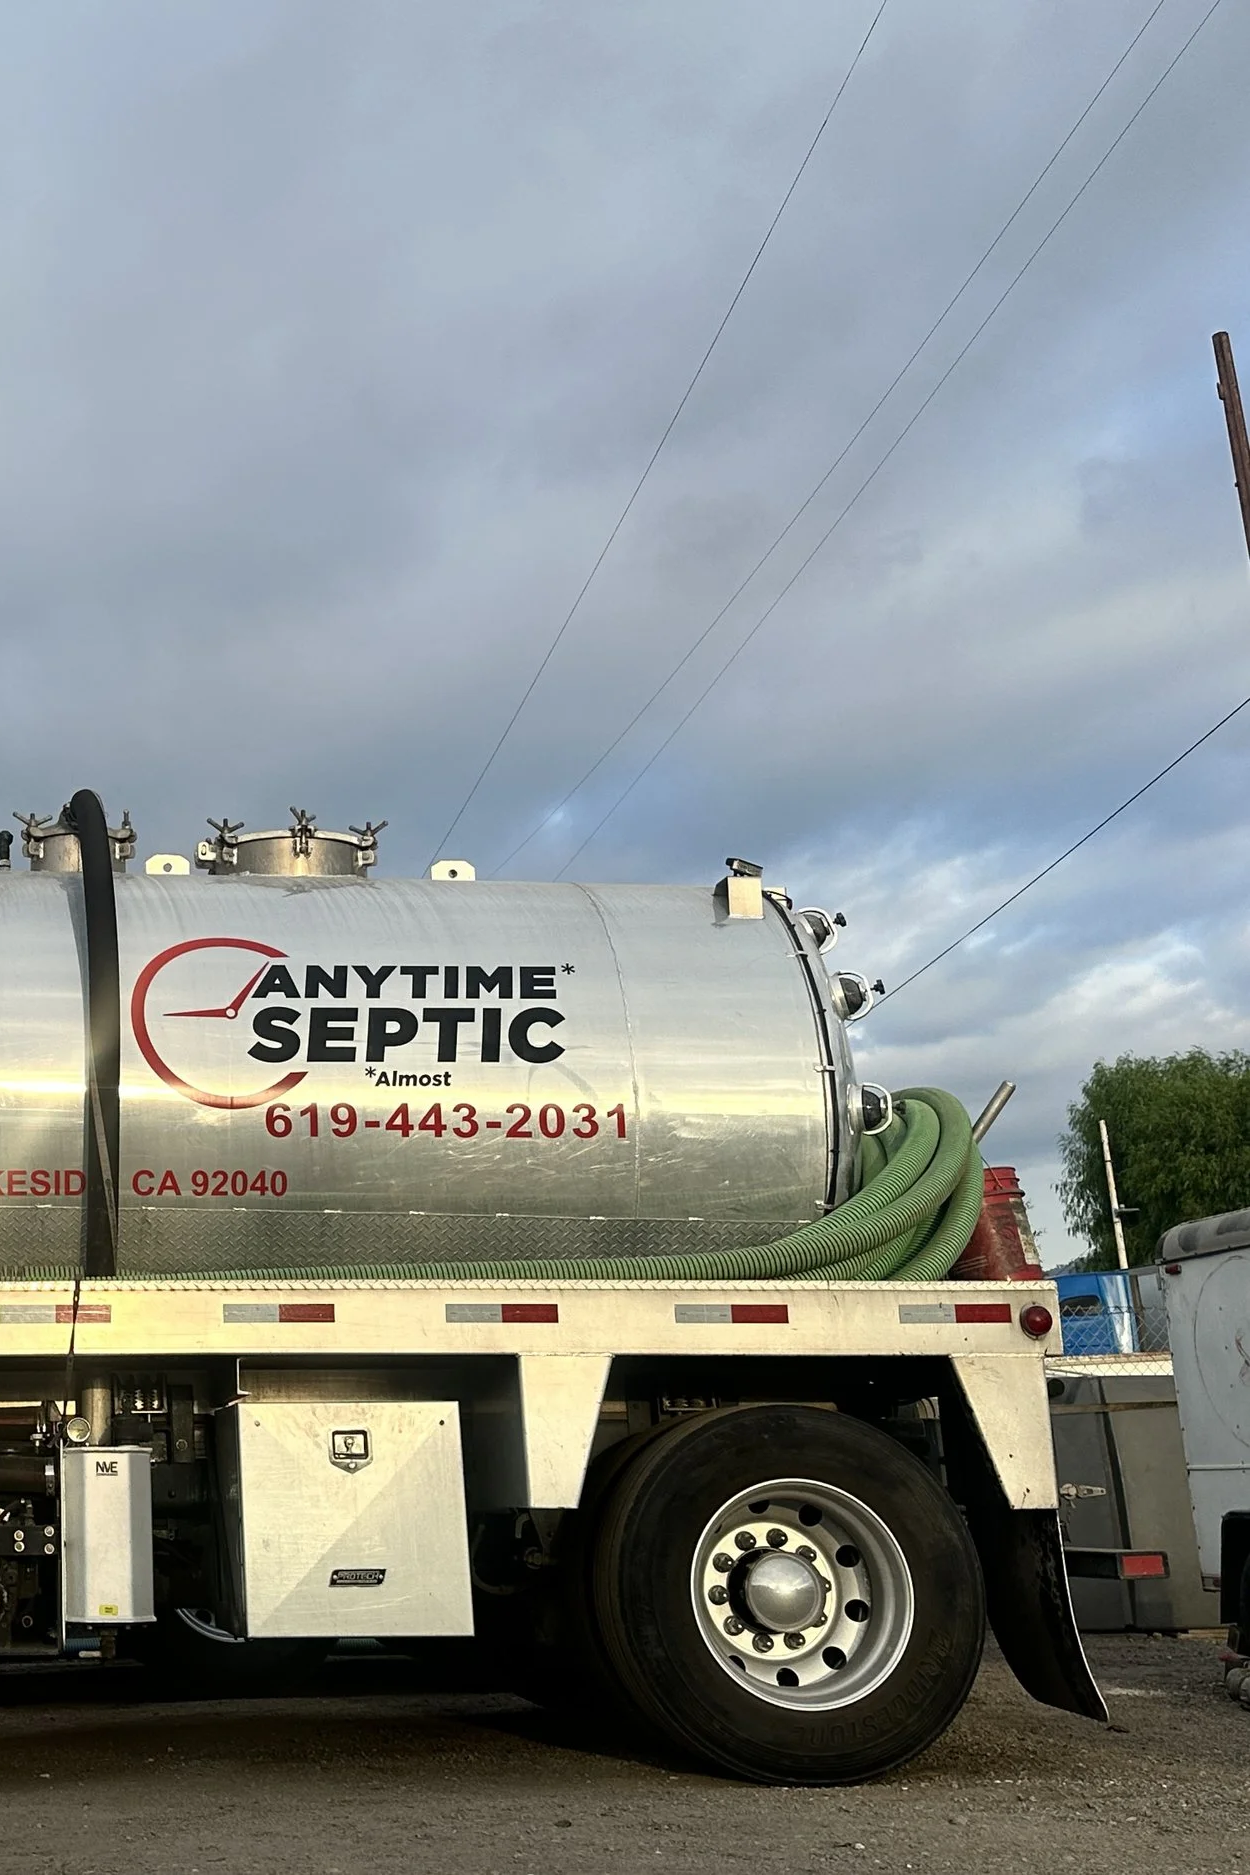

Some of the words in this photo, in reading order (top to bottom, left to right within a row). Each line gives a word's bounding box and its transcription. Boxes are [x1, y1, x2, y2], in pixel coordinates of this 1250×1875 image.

[247, 1007, 566, 1063] SEPTIC
[265, 1102, 629, 1139] 619-443-2031
[132, 1170, 182, 1197] CA
[191, 1170, 288, 1197] 92040
[95, 1461, 118, 1473] NVE
[790, 1629, 954, 1748] BRIDGESTONE
